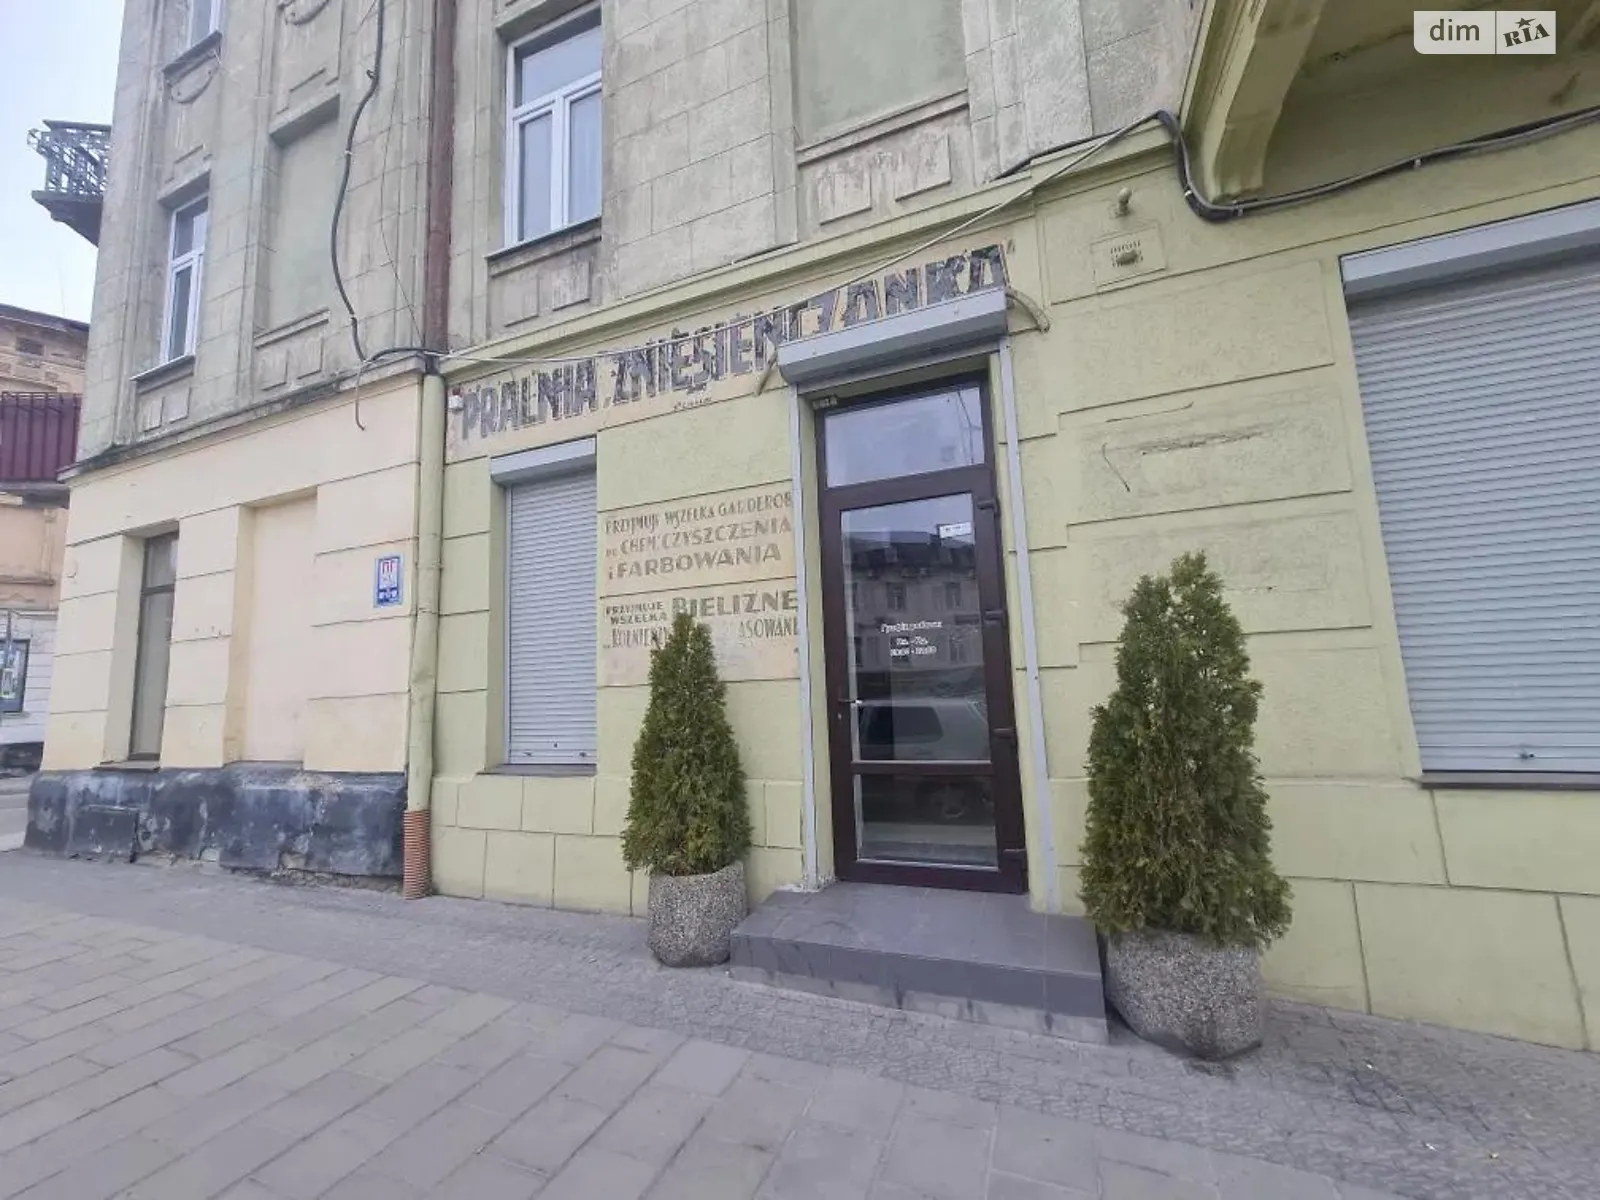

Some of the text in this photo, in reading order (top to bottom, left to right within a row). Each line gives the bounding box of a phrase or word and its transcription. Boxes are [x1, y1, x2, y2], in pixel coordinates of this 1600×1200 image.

[462, 358, 599, 441] PRALNIA
[661, 516, 792, 550] CZYSZCZENIA
[616, 543, 782, 578] FARBOWANIA
